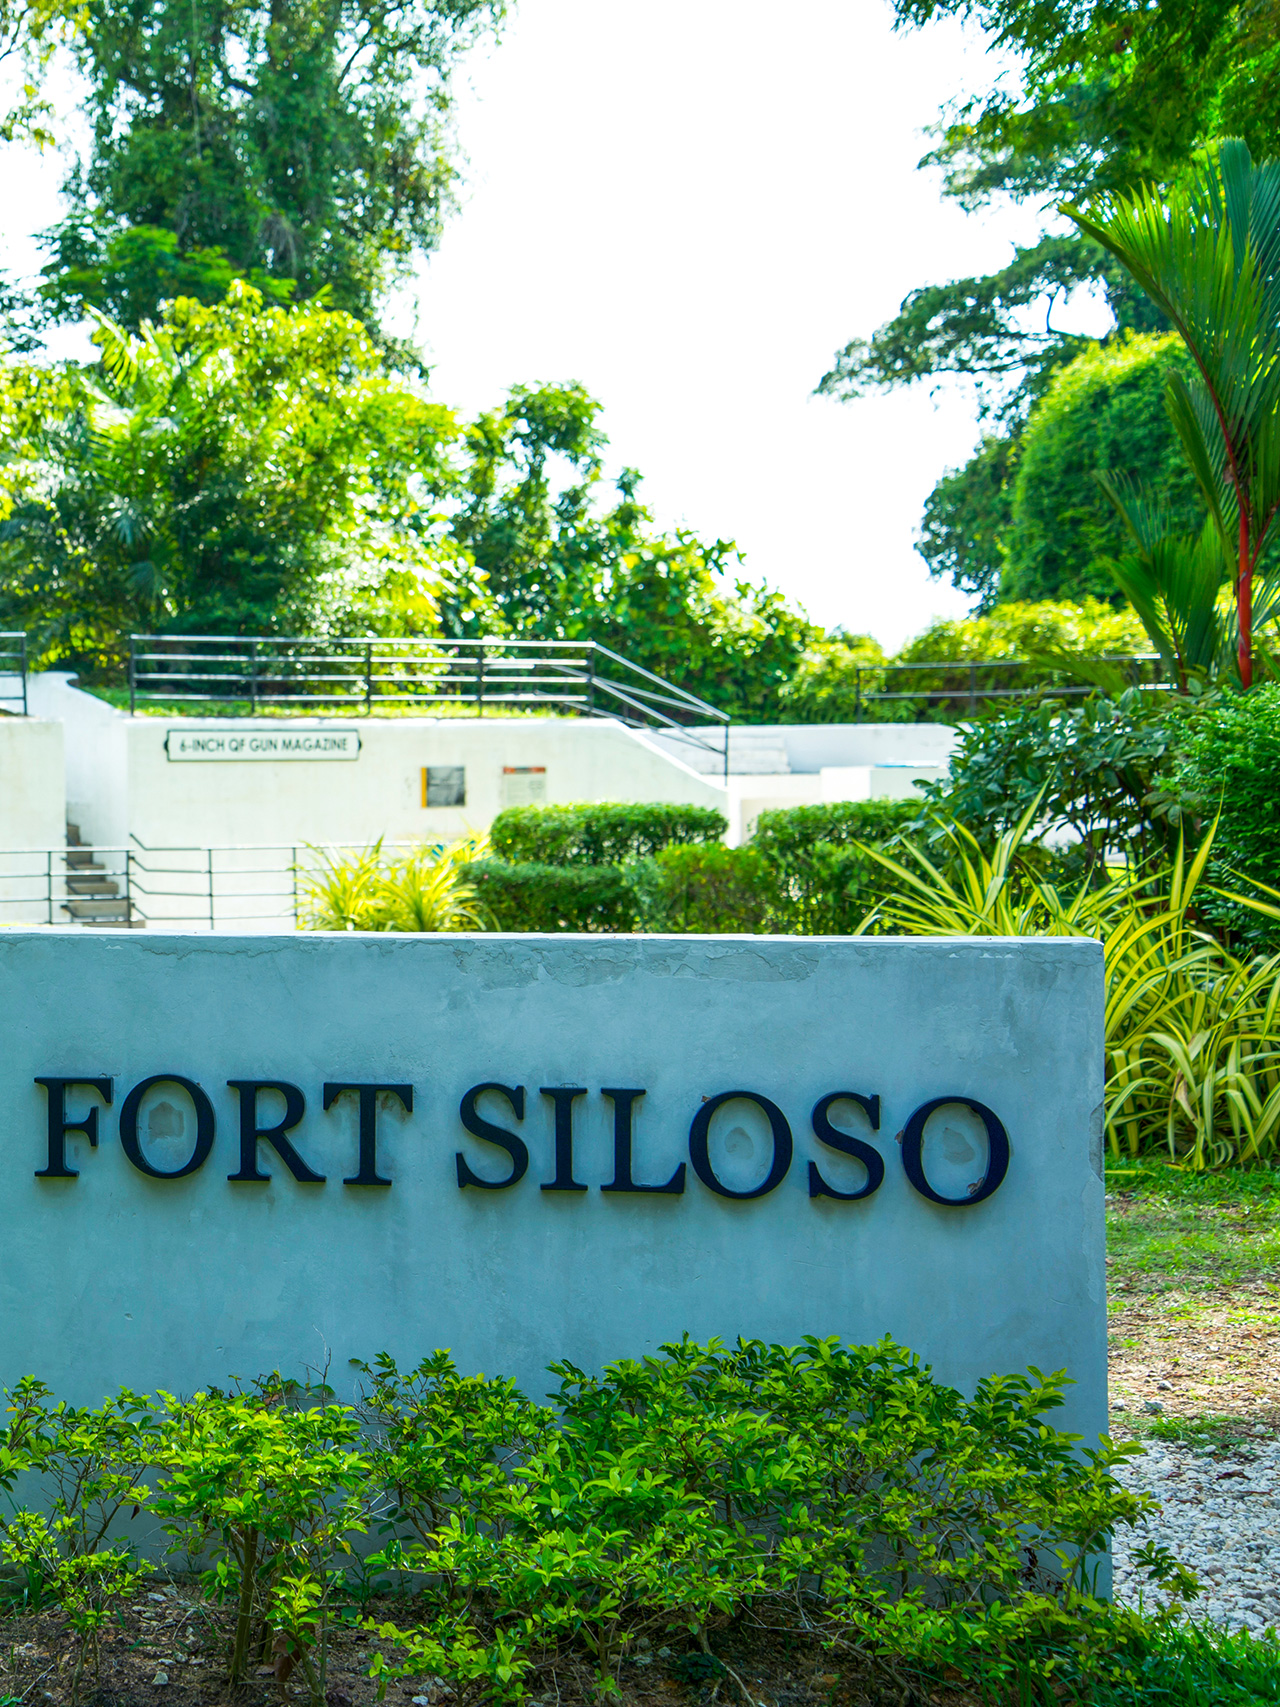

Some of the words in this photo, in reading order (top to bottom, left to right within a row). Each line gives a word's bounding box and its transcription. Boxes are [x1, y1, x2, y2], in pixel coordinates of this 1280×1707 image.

[179, 737, 225, 753] 6-INCH
[249, 737, 279, 752] GUN
[280, 737, 349, 752] MAGAZINE
[33, 1073, 414, 1188] FORT
[455, 1082, 1012, 1207] SILOSO
